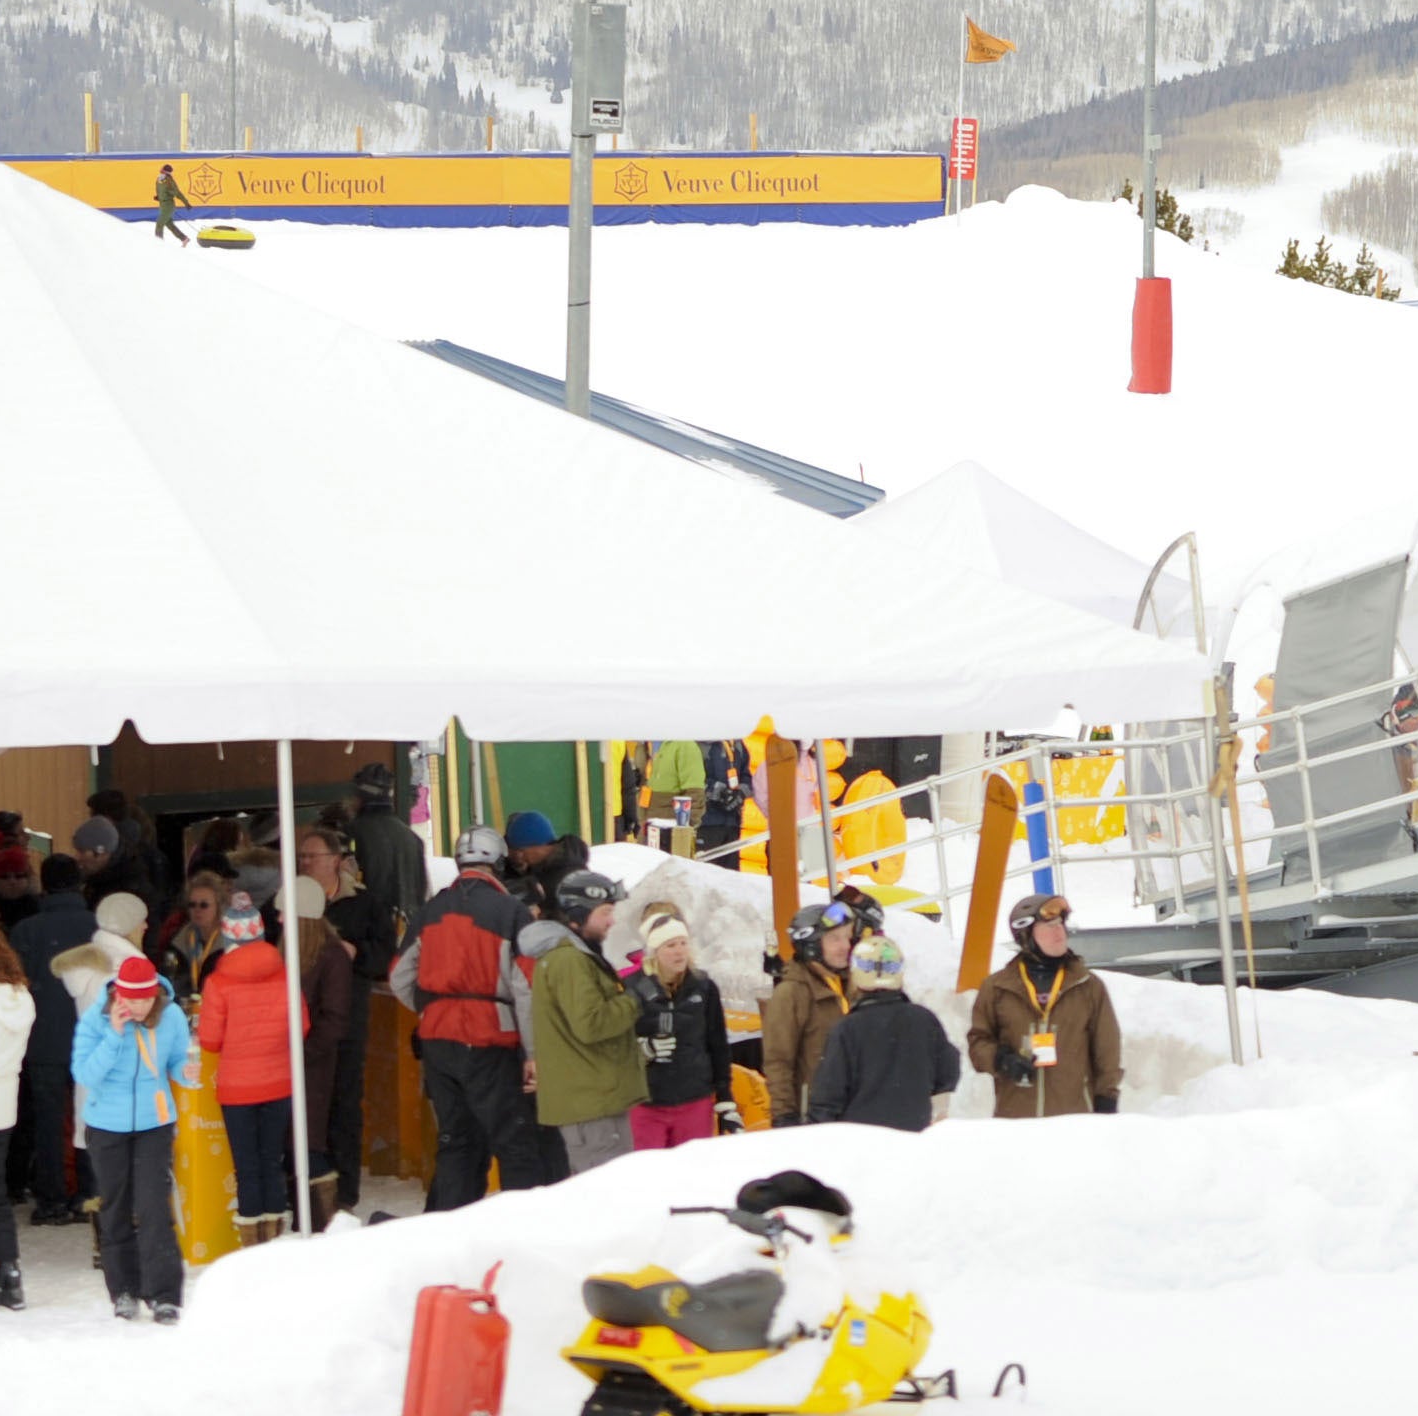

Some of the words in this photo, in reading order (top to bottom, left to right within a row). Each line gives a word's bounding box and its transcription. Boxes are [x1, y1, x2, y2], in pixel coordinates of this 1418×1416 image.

[237, 170, 296, 195] Veuve
[301, 169, 387, 200] Clicquot
[662, 169, 724, 194] Veuve
[730, 168, 820, 198] Clicquot
